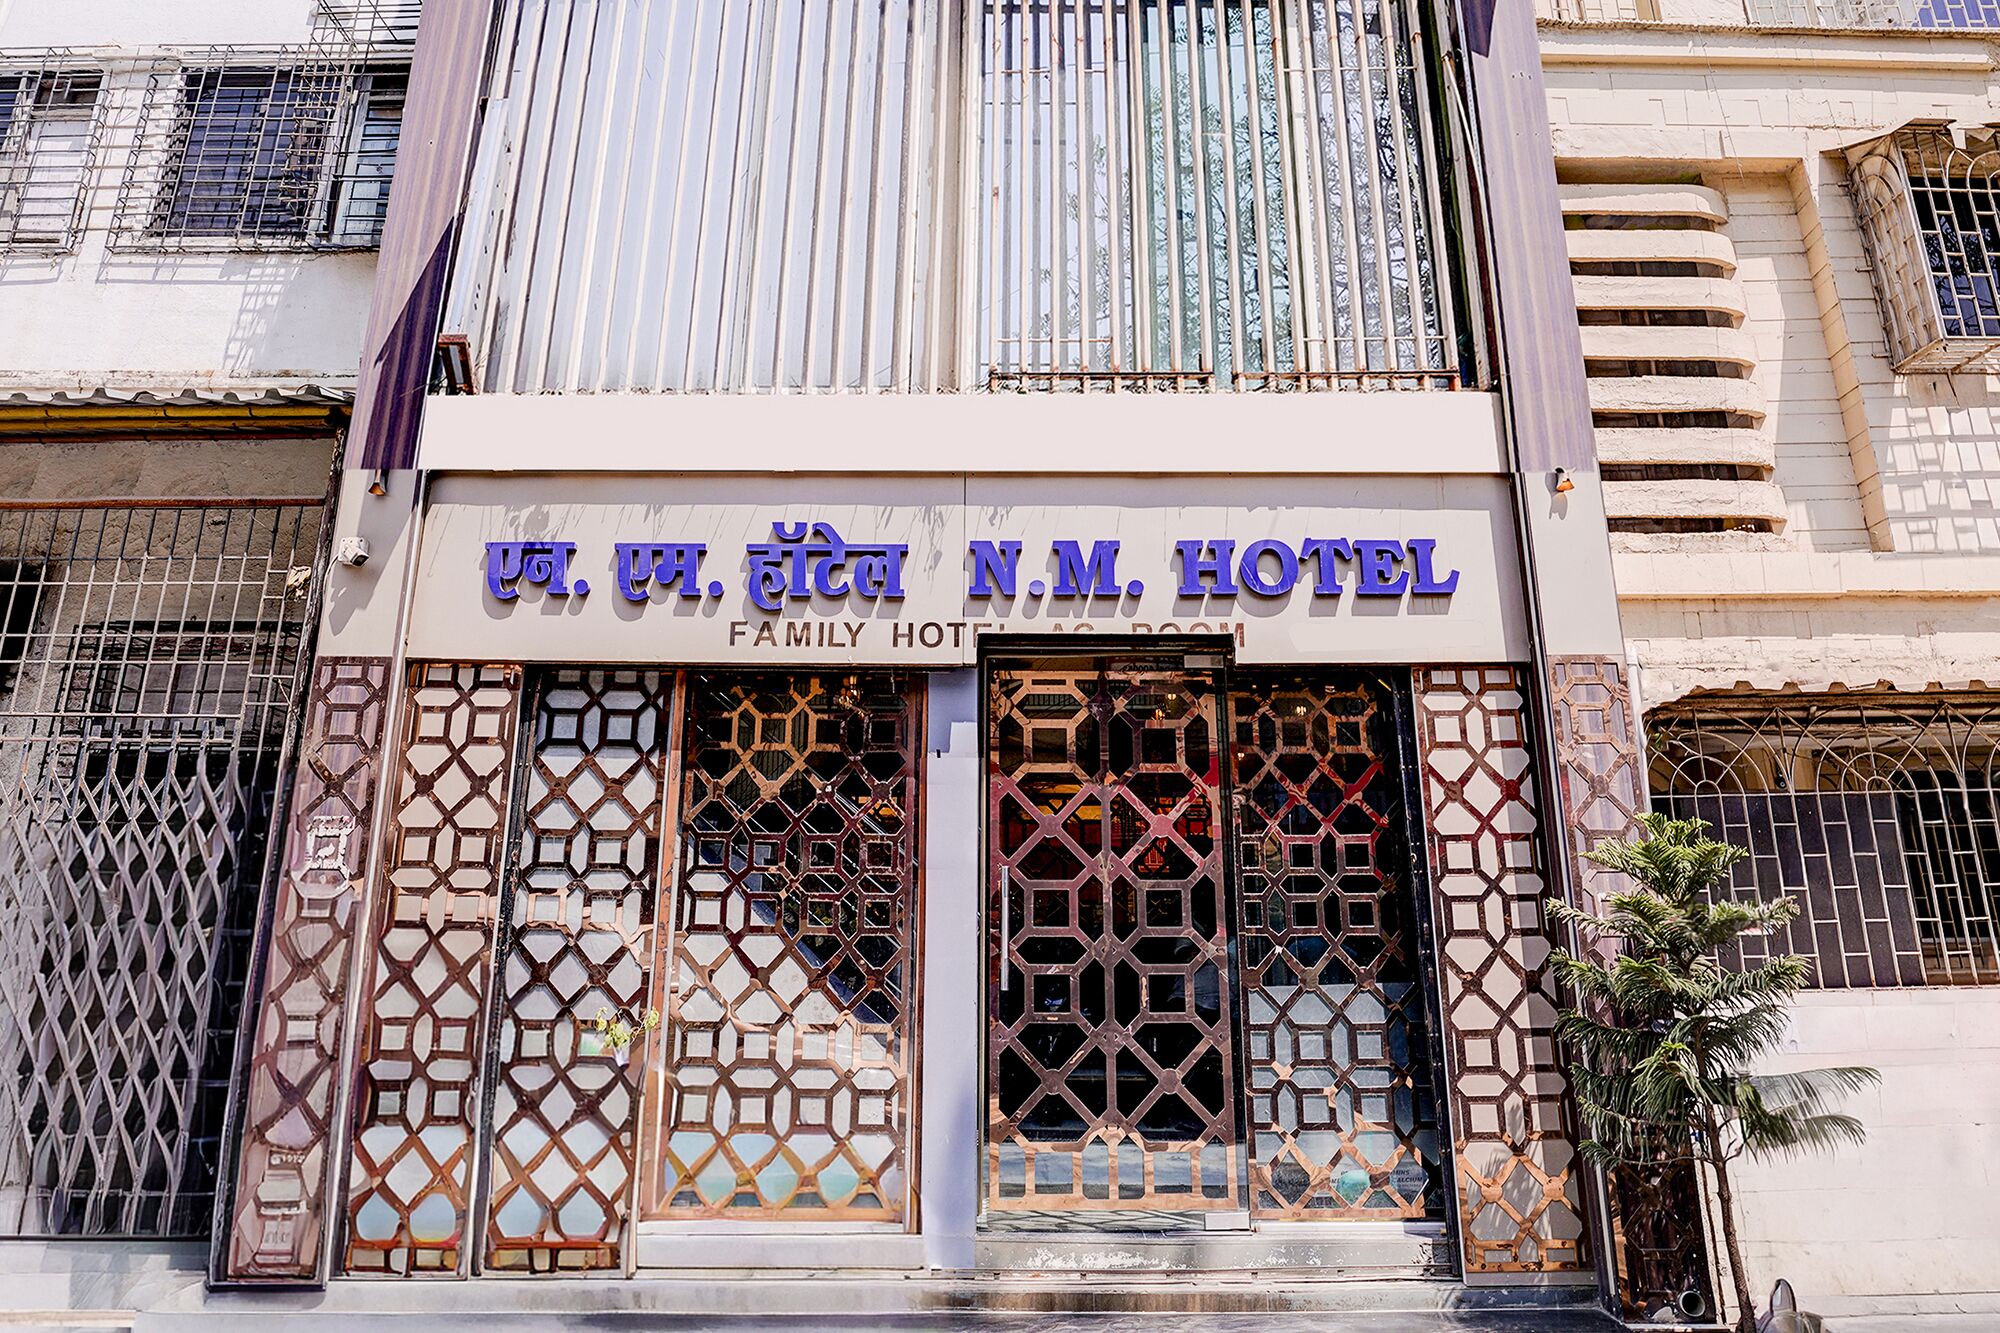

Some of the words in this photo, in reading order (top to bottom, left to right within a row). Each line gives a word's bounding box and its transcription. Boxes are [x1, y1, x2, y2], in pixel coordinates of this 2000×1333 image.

[485, 541, 591, 600] एन.
[614, 542, 724, 601] एम.
[746, 521, 909, 611] हॉटेल
[968, 540, 1146, 598] N.M.
[1176, 538, 1461, 596] HOTEL
[729, 620, 866, 648] FAMILY
[892, 621, 1005, 648] HOT
